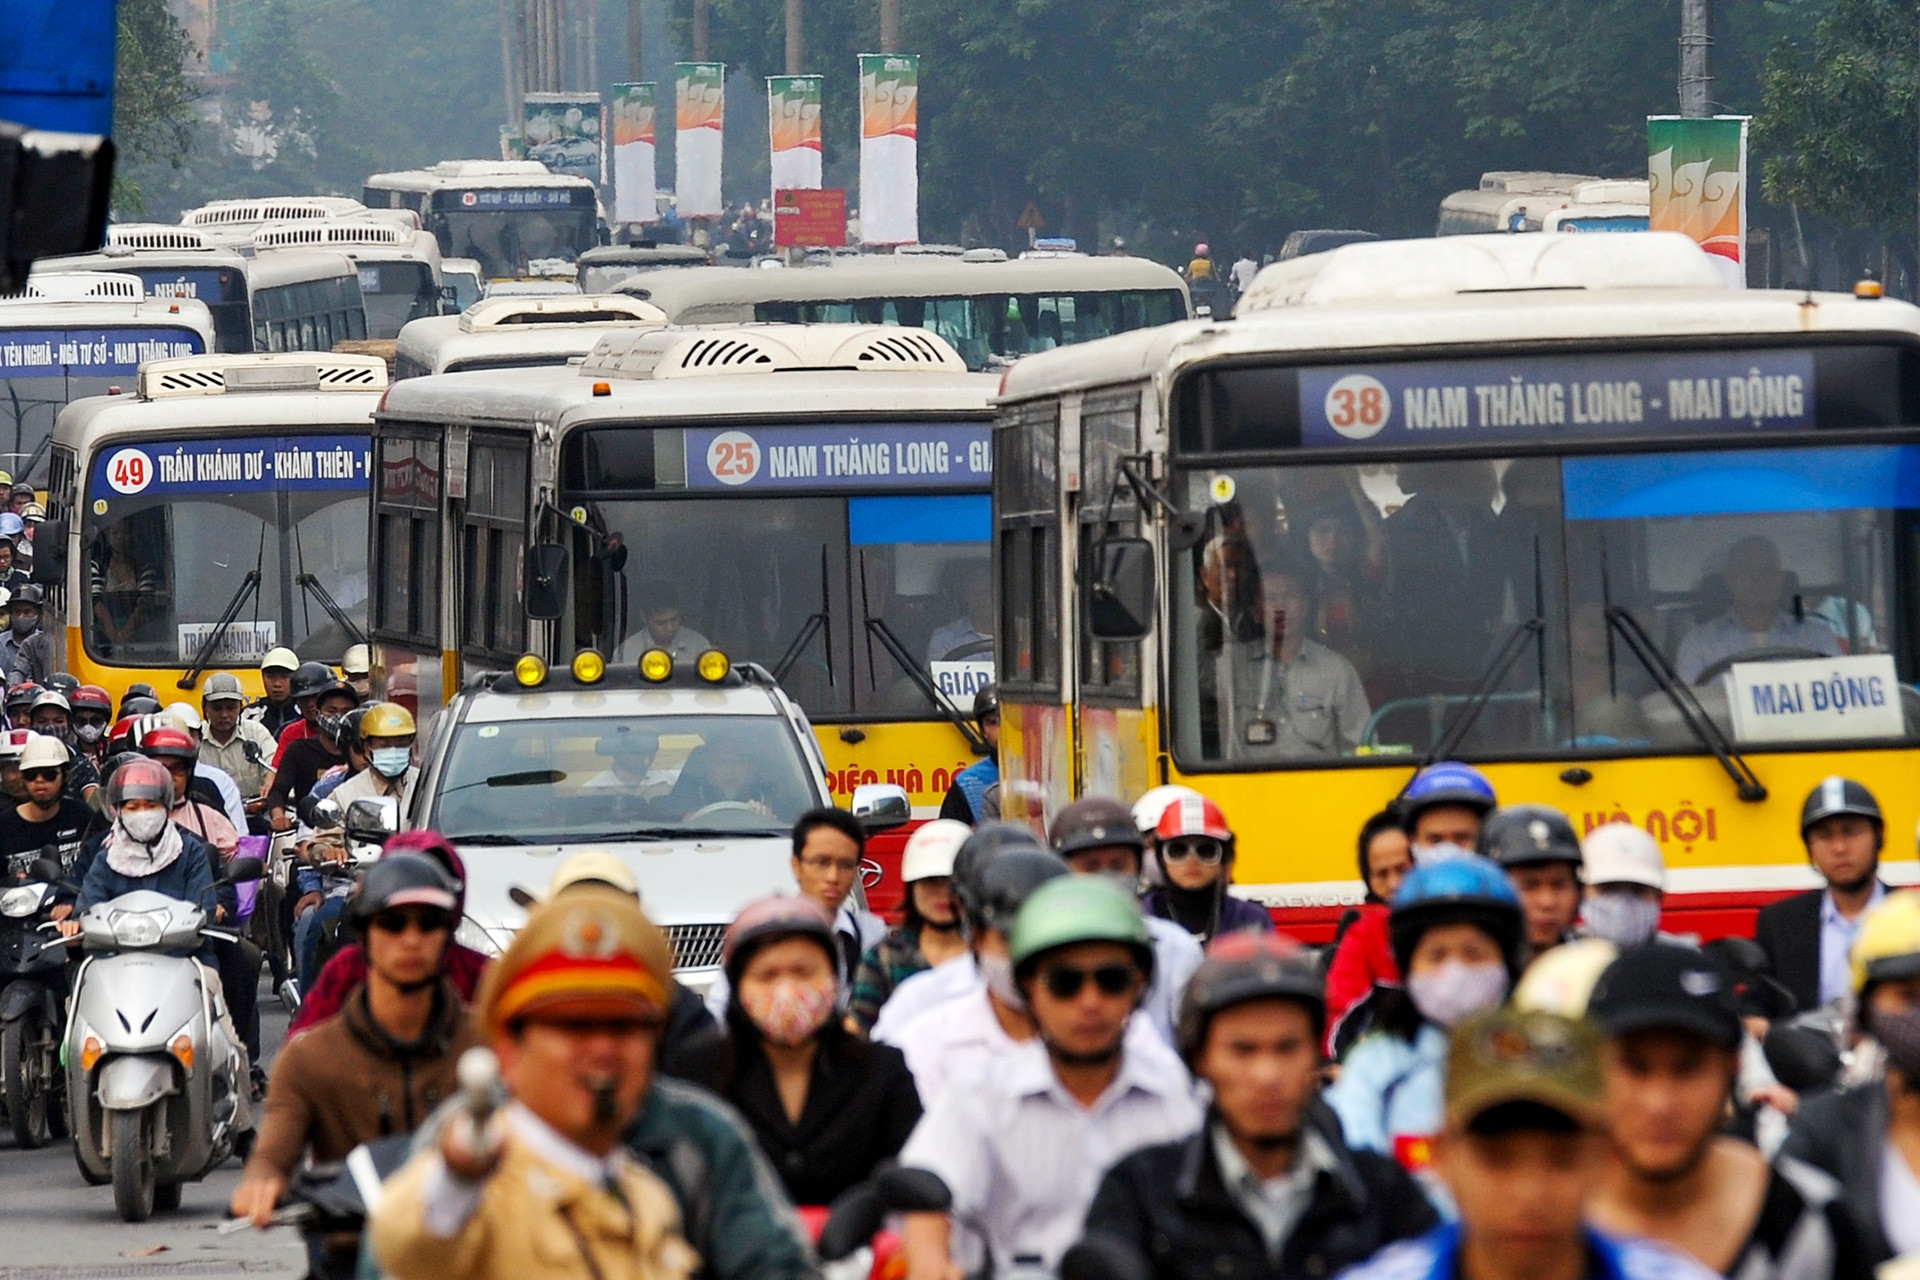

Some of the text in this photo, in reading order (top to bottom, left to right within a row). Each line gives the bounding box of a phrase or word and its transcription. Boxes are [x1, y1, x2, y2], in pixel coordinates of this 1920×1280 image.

[114, 342, 137, 364] NAM
[1332, 387, 1383, 427] 38
[1403, 386, 1468, 429] NAM
[1475, 376, 1565, 426] THĂNG
[1571, 381, 1644, 423] LONG
[1668, 378, 1721, 420] MAI
[1727, 367, 1804, 428] ĐỘNG
[115, 457, 144, 486] 49
[158, 447, 194, 483] TRẦN
[197, 448, 242, 481] KHÁNH
[244, 450, 264, 480] DƯ
[274, 446, 313, 479] KHÂM
[316, 445, 354, 478] THIÊN
[715, 442, 754, 476] 25
[769, 445, 818, 478] NAM
[823, 438, 890, 476] THĂNG
[896, 441, 949, 475] LONG
[968, 440, 992, 473] GI
[1752, 672, 1886, 715] MAI ĐỘNG
